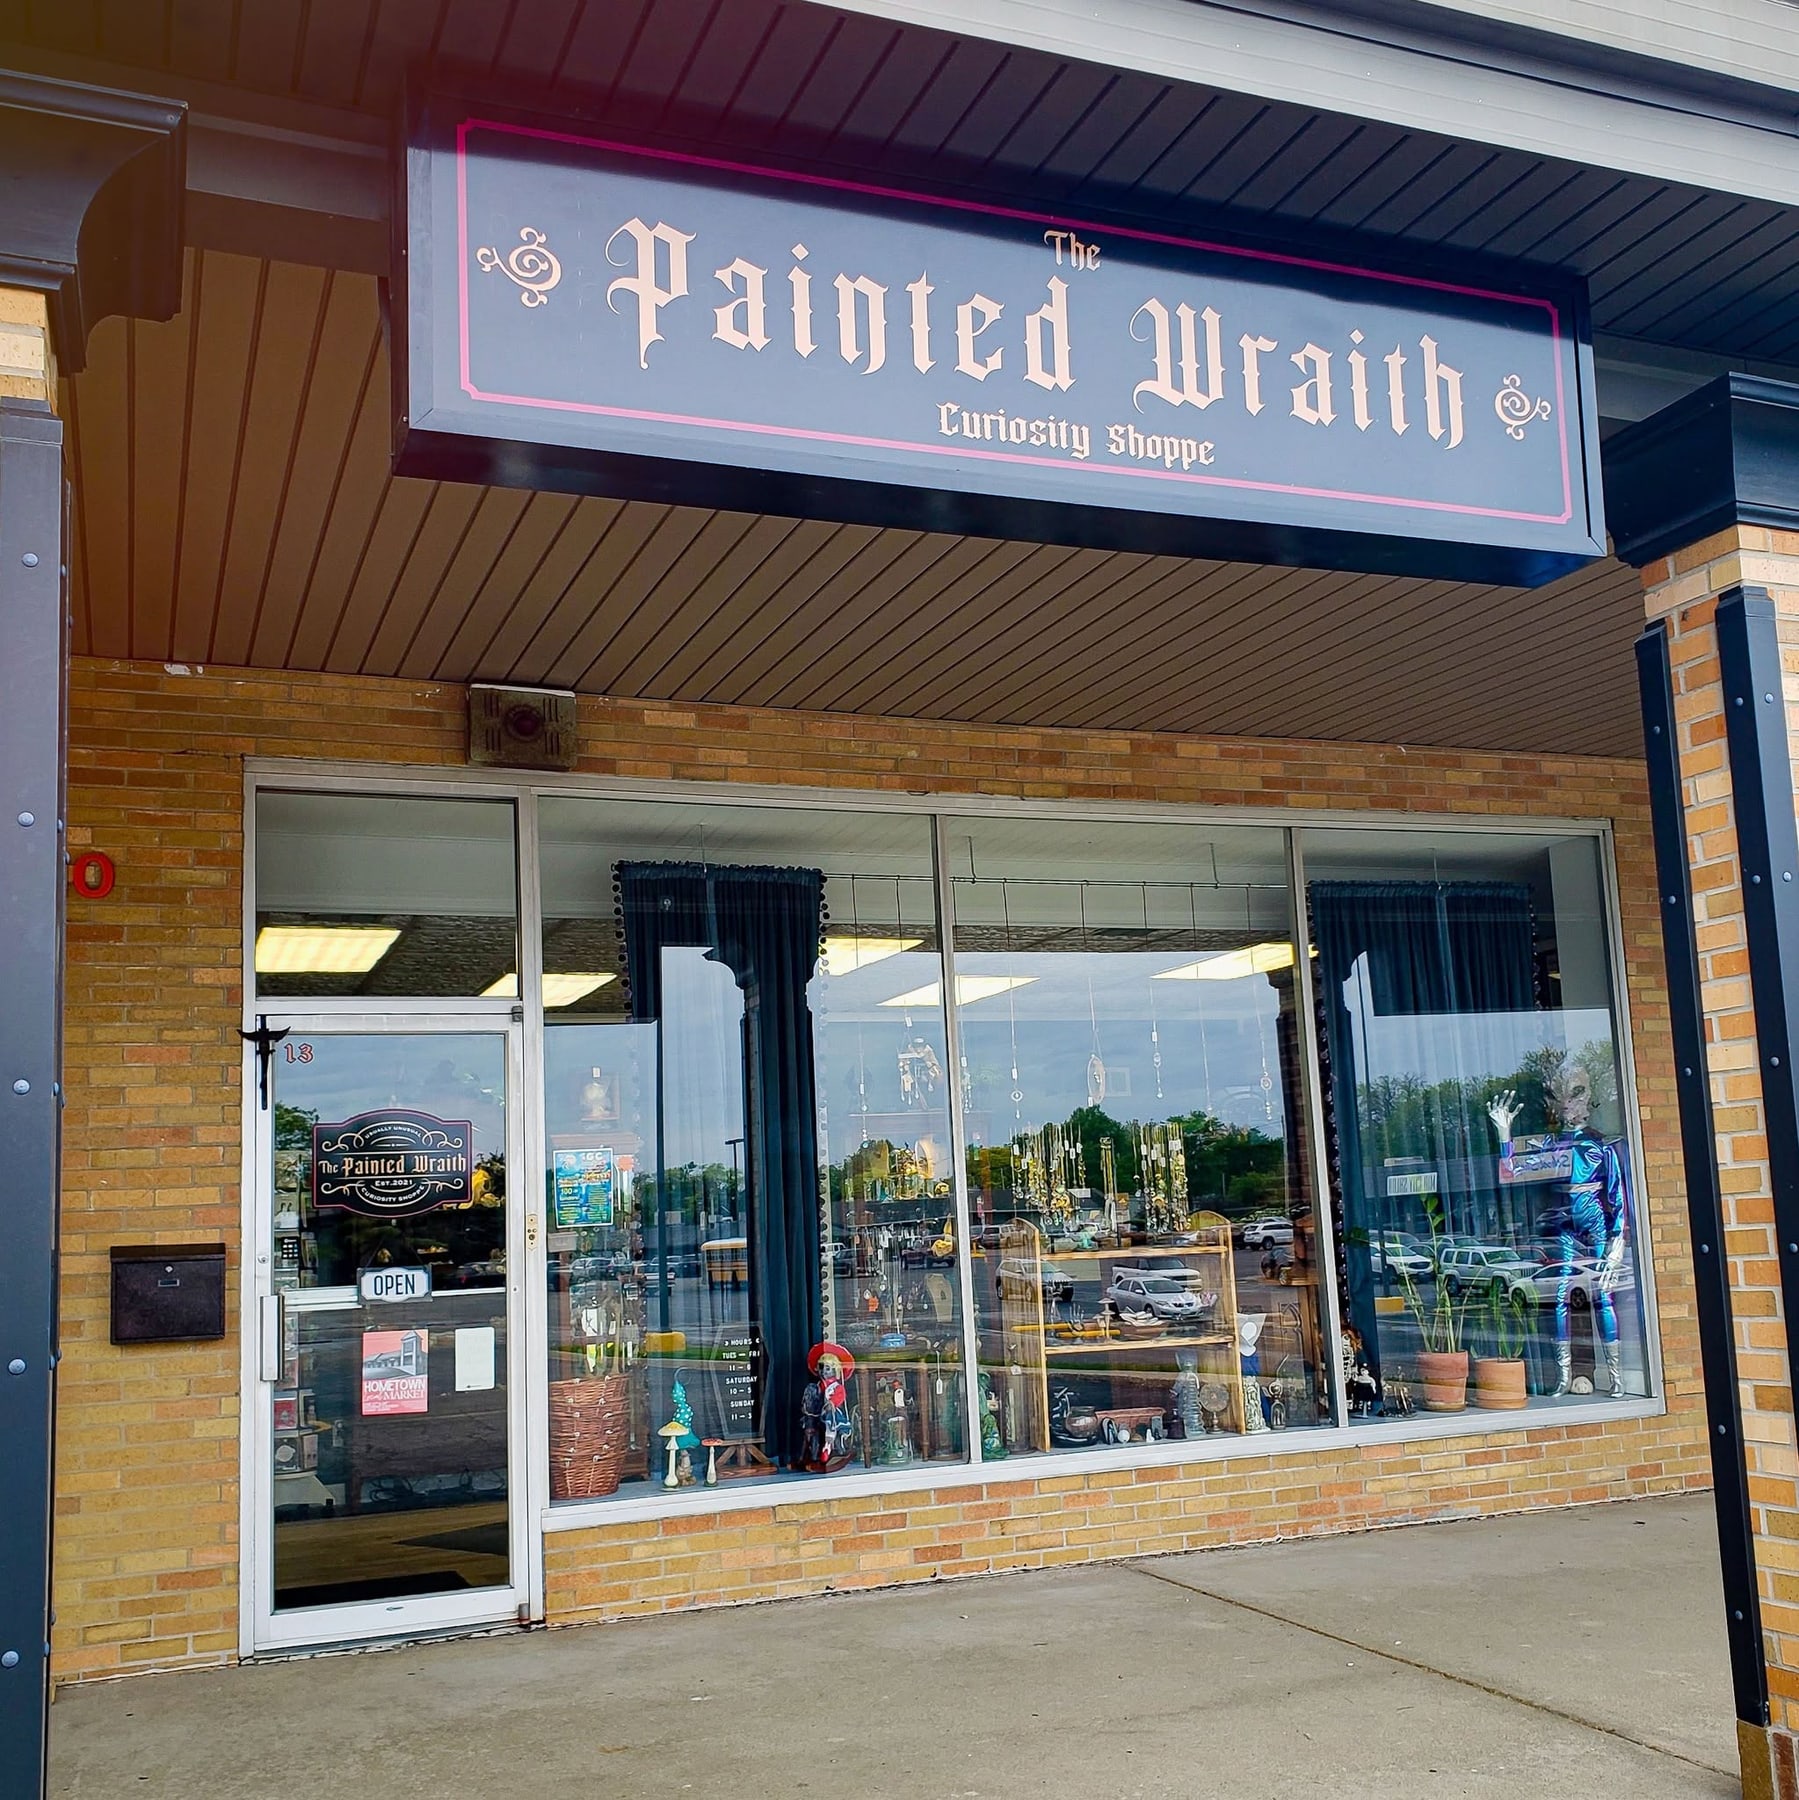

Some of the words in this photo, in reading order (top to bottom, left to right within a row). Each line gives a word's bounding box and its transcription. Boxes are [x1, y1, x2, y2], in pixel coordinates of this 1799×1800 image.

[1044, 230, 1101, 271] The
[605, 217, 1079, 393] Painted
[1128, 297, 1463, 450] Wraith
[936, 402, 1091, 459] Curiosity
[1105, 423, 1215, 471] Shoppe
[284, 1043, 313, 1063] 13
[364, 1126, 392, 1139] USUALLY
[318, 1160, 339, 1174] The
[341, 1155, 405, 1177] Painted
[411, 1153, 467, 1174] Wraith
[361, 1187, 397, 1202] CURIOSITY
[398, 1184, 425, 1202] SHOPPE
[374, 1274, 415, 1296] OPEN
[731, 1338, 753, 1346] HOURS
[749, 1350, 760, 1358] FRI
[365, 1379, 425, 1392] HOMETOWN
[725, 1376, 758, 1385] SATURDAY
[383, 1391, 425, 1400] MARKET
